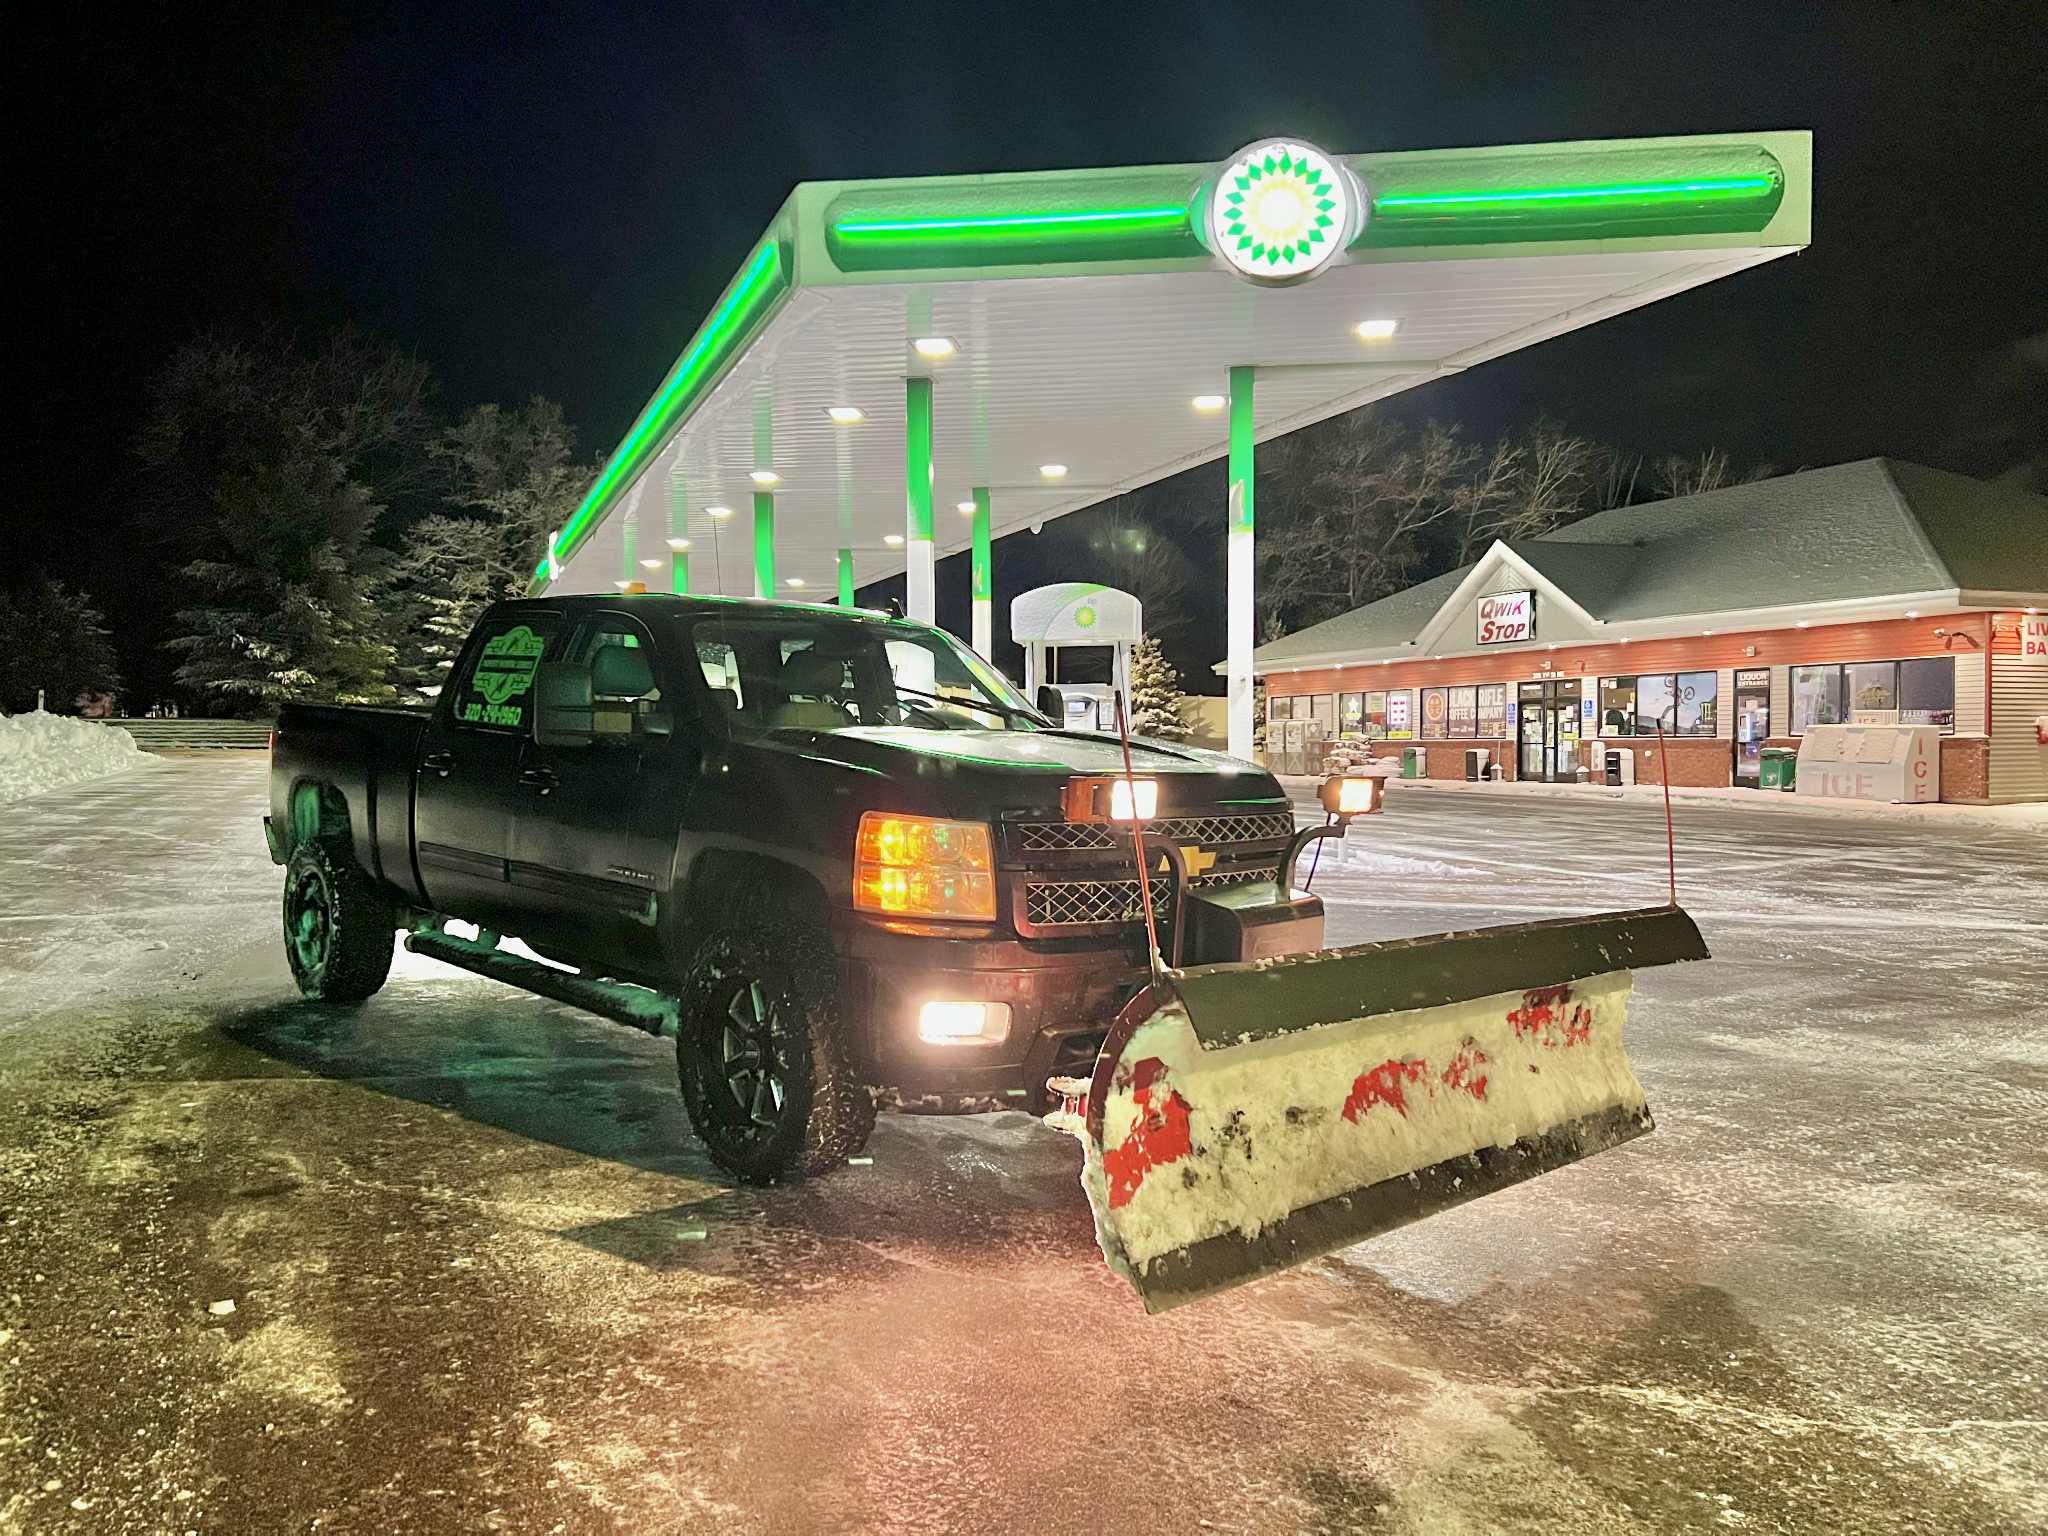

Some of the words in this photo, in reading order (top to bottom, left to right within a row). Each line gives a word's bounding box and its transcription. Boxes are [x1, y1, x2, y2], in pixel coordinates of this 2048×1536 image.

[1481, 599, 1526, 619] QWIK
[1481, 620, 1526, 642] STOP
[2026, 641, 2047, 655] BA
[1478, 687, 1504, 706] RIFLE
[1913, 737, 1928, 802] ICE
[1820, 772, 1873, 797] ICE
